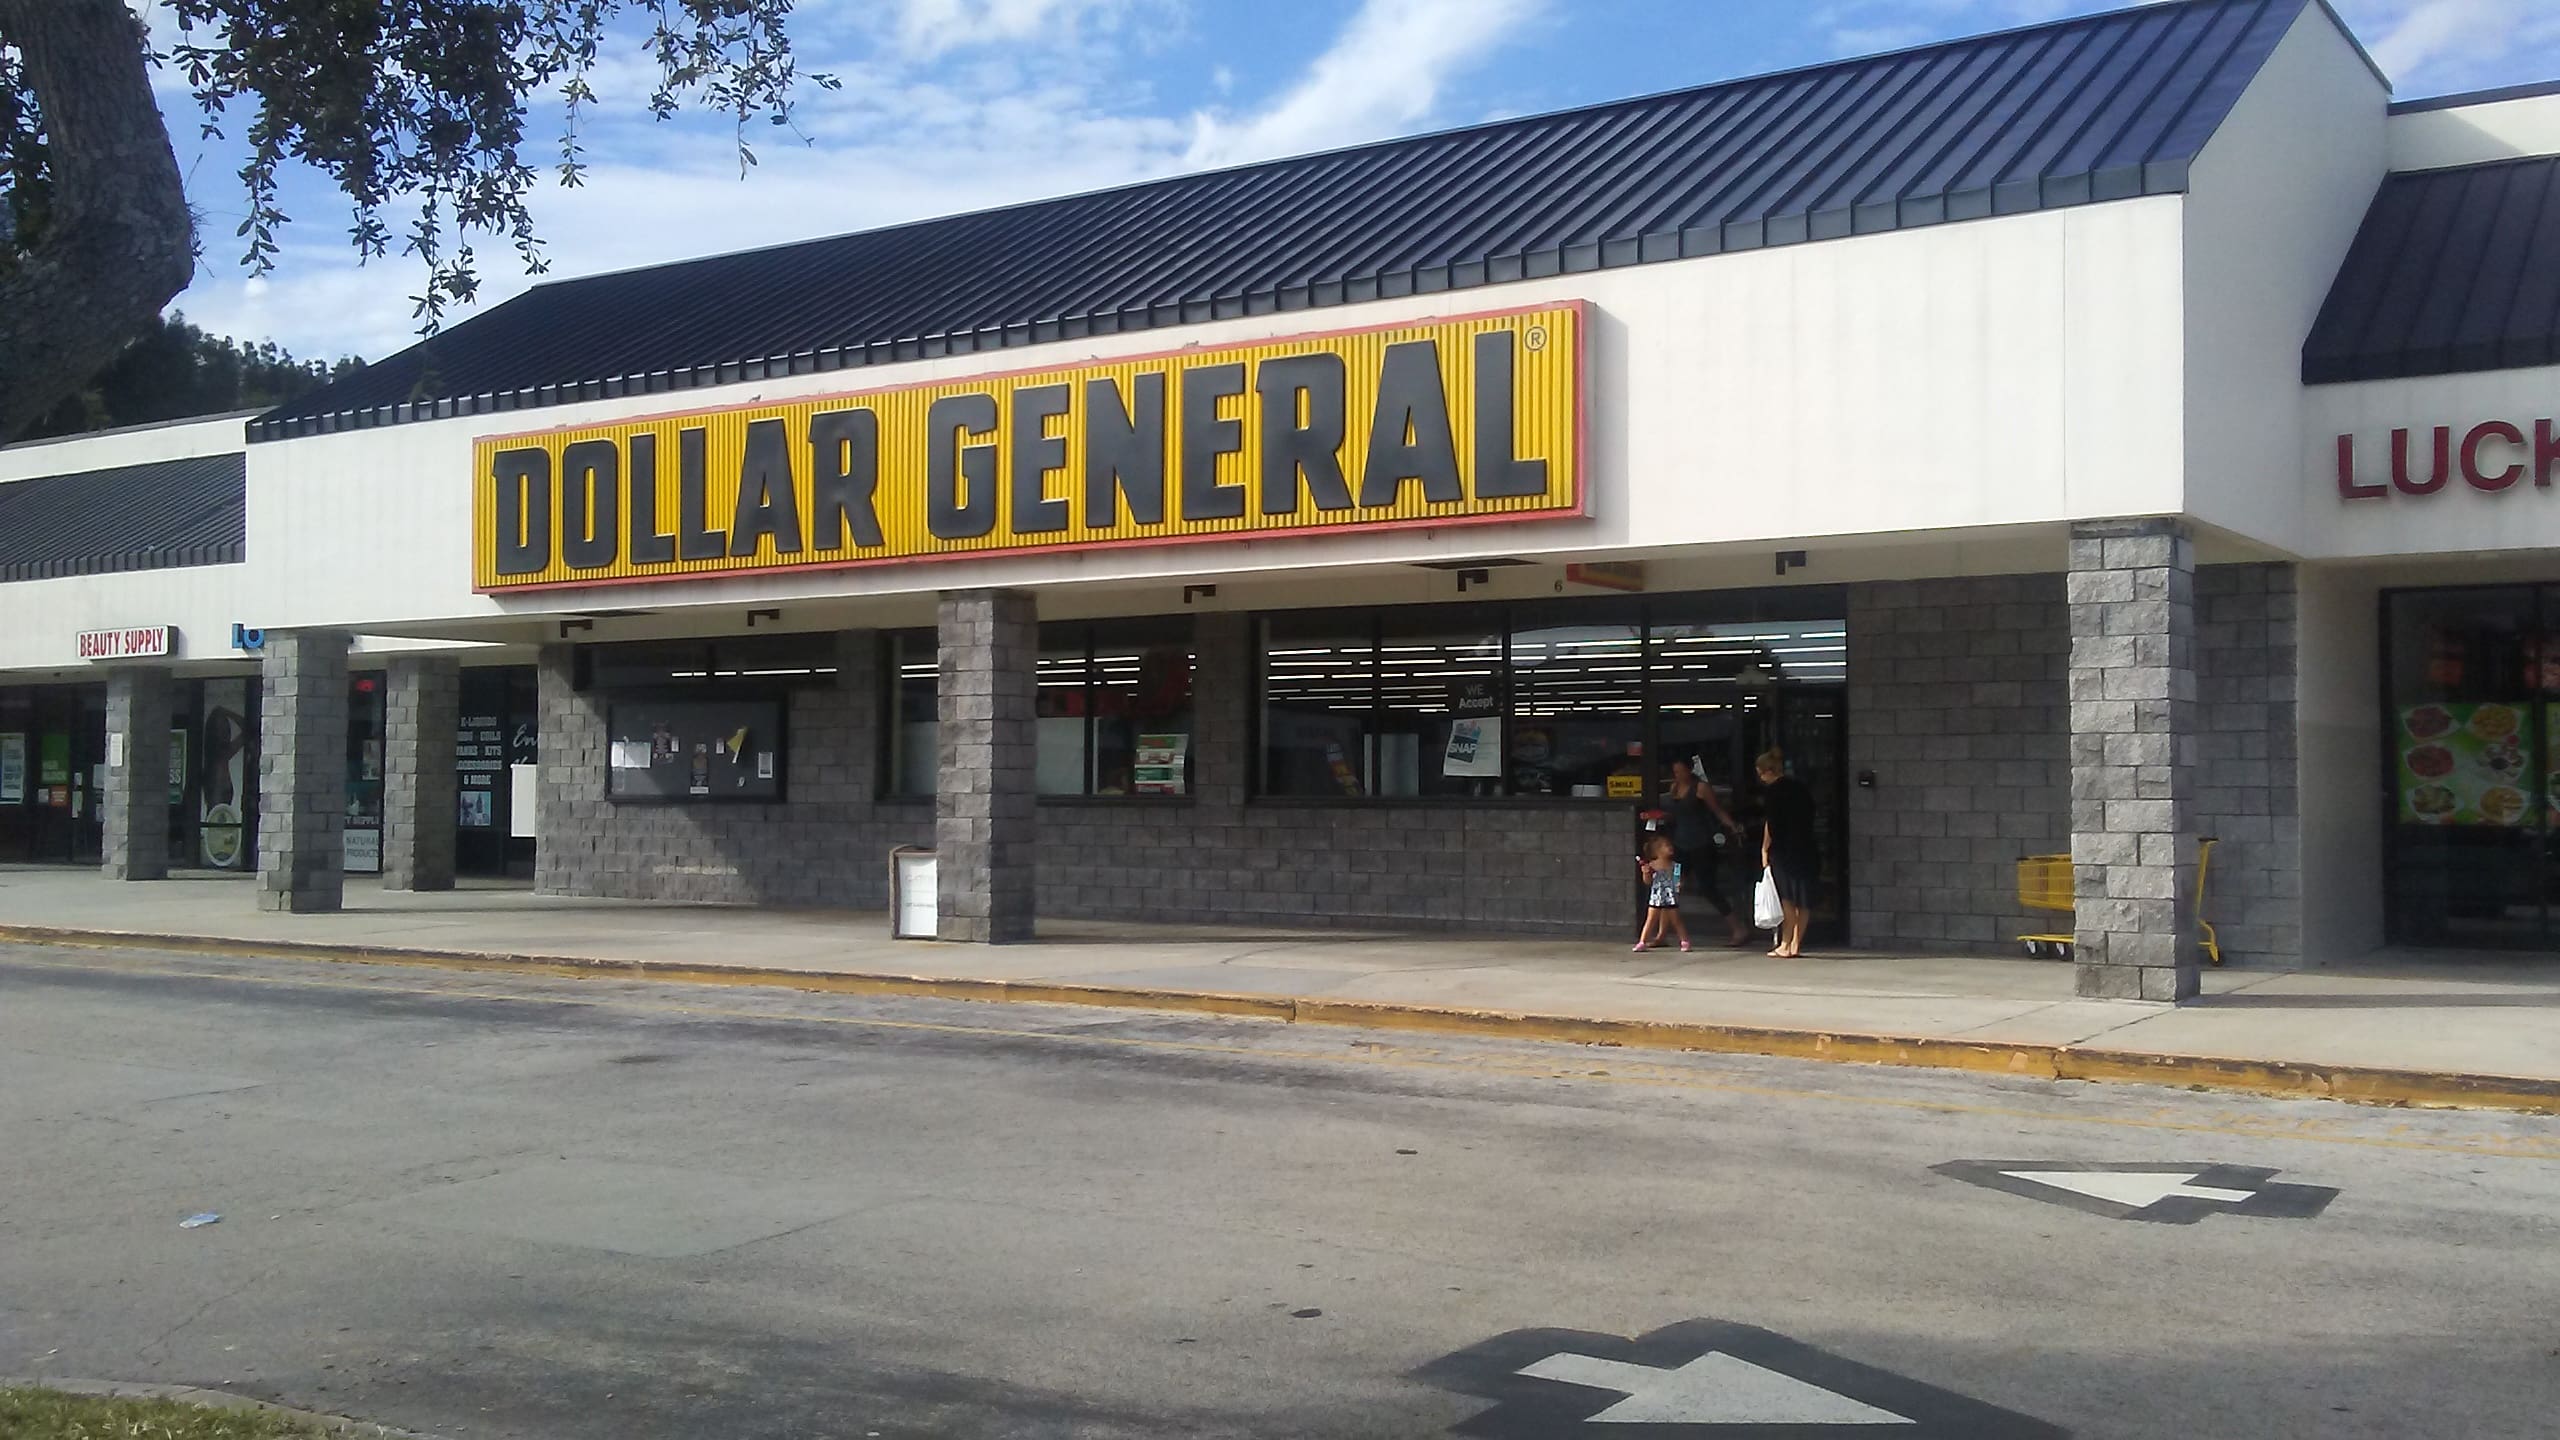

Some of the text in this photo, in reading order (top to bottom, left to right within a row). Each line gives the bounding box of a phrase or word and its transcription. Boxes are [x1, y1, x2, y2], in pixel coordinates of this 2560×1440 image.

[493, 407, 886, 576] DOLLAR
[927, 329, 1548, 540] GENERAL
[1554, 580, 1563, 592] 6
[79, 628, 165, 658] BEAUTY SUPPLY
[1458, 695, 1494, 710] Accept
[484, 745, 502, 756] KITS
[1448, 742, 1478, 754] SNAP
